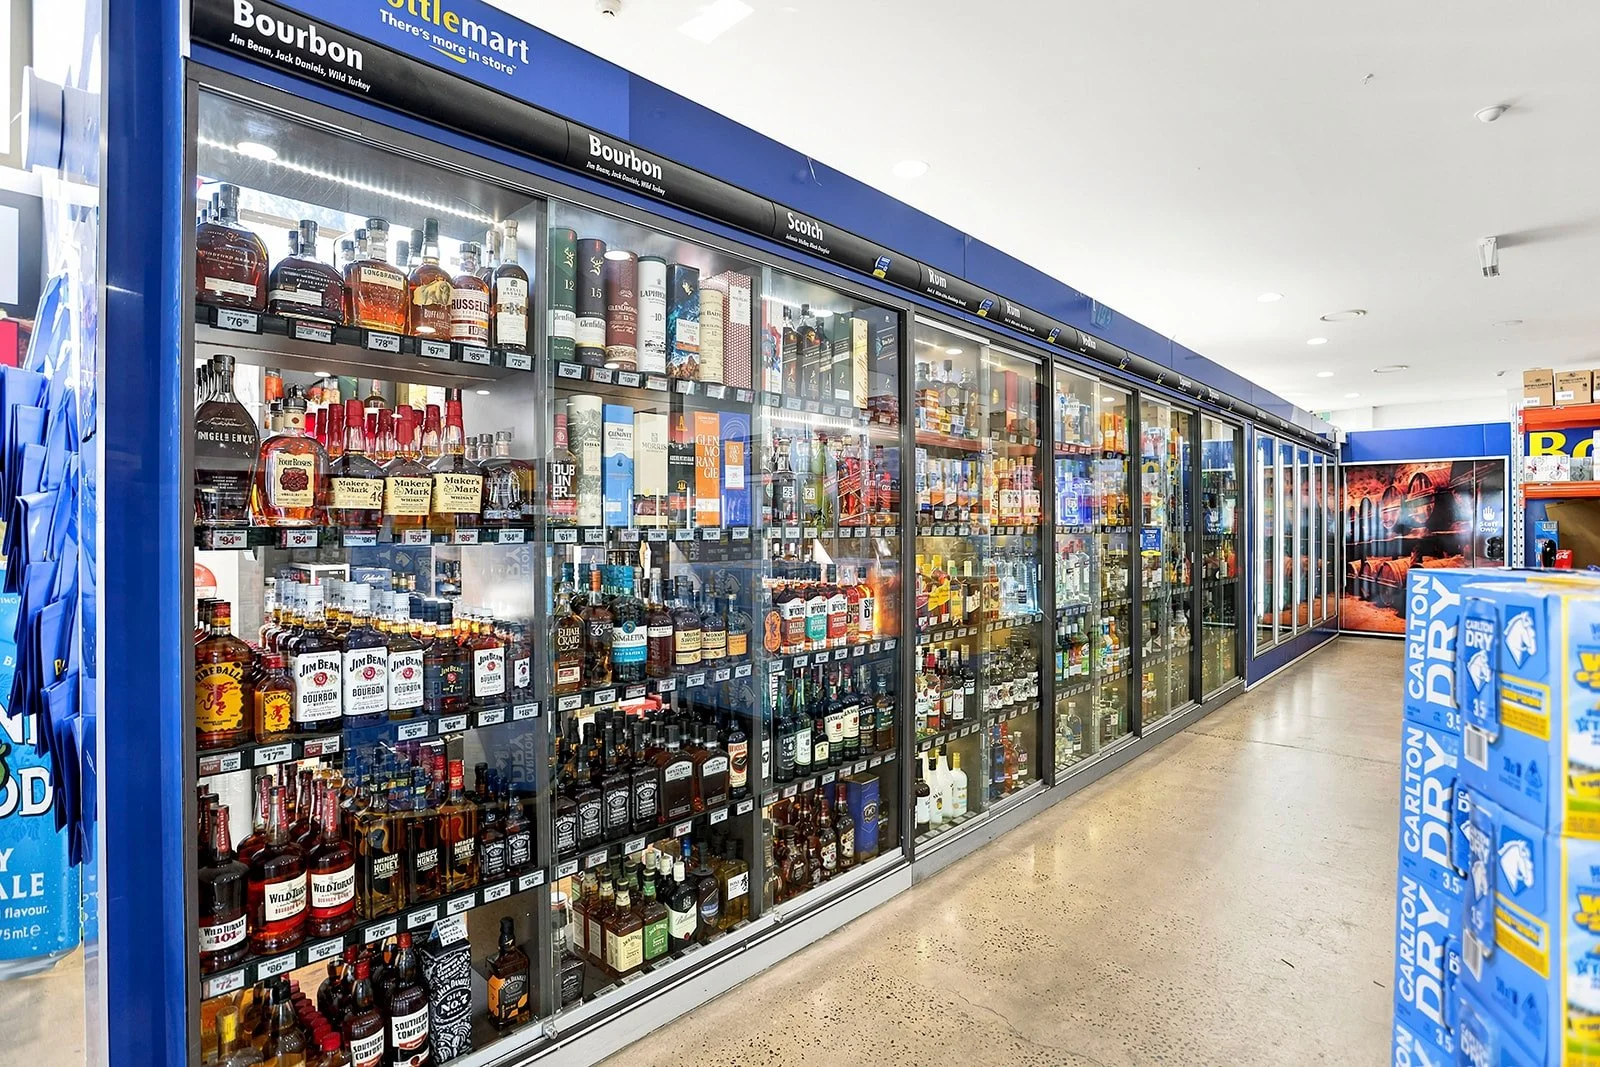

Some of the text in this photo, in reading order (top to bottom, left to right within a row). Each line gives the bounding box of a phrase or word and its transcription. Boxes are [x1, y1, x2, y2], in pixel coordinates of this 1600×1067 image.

[234, 0, 363, 71] Bourbon
[380, 9, 430, 41] There's
[432, 34, 466, 55] more
[468, 47, 480, 62] in
[229, 32, 371, 93] Jim Beam, Jack Daniels, Wild Turkey
[588, 133, 662, 180] Bourbon
[787, 212, 823, 241] Scotch
[363, 268, 402, 284] LONGBRANCH
[928, 268, 947, 289] Rum
[564, 279, 575, 291] 12
[591, 287, 602, 300] 15
[653, 312, 663, 322] 10
[1006, 301, 1021, 319] Rum
[641, 441, 668, 452] MORRIS
[696, 434, 720, 446] GLEN
[704, 445, 720, 457] MO
[278, 457, 313, 468] Four Roses
[552, 463, 576, 476] DUB
[696, 456, 715, 468] RAN
[704, 467, 719, 479] GIE
[337, 479, 369, 488] Maker's
[393, 478, 431, 490] Maker's
[443, 475, 480, 488] Maker's
[346, 486, 369, 495] Mark
[404, 486, 430, 498] Mark
[454, 485, 480, 497] Mark
[552, 486, 569, 498] ER
[558, 626, 580, 638] ELIJAH
[1408, 574, 1430, 700] CARLTON
[557, 636, 580, 647] CRAIG
[1425, 576, 1460, 710] DRY
[1465, 631, 1493, 651] DRY
[300, 657, 341, 677] JIM BEAM
[350, 654, 387, 673] JIM BEAM
[389, 655, 423, 673] JIM BEAM
[302, 690, 338, 705] BOURBON
[352, 685, 385, 699] BOURBON
[1404, 726, 1425, 853] CARLTON
[1421, 732, 1458, 872] DRY
[374, 859, 399, 875] HONEY
[417, 853, 439, 868] HONEY
[312, 880, 333, 895] WILD
[268, 892, 293, 906] WILD
[5, 902, 50, 919] flavour.
[203, 925, 223, 938] WILD
[213, 931, 238, 945] 101
[1399, 874, 1418, 1003] CARLTON
[1416, 885, 1449, 1030] DRY
[395, 1011, 429, 1032] SOUTHERN
[397, 1020, 428, 1041] COMFORT
